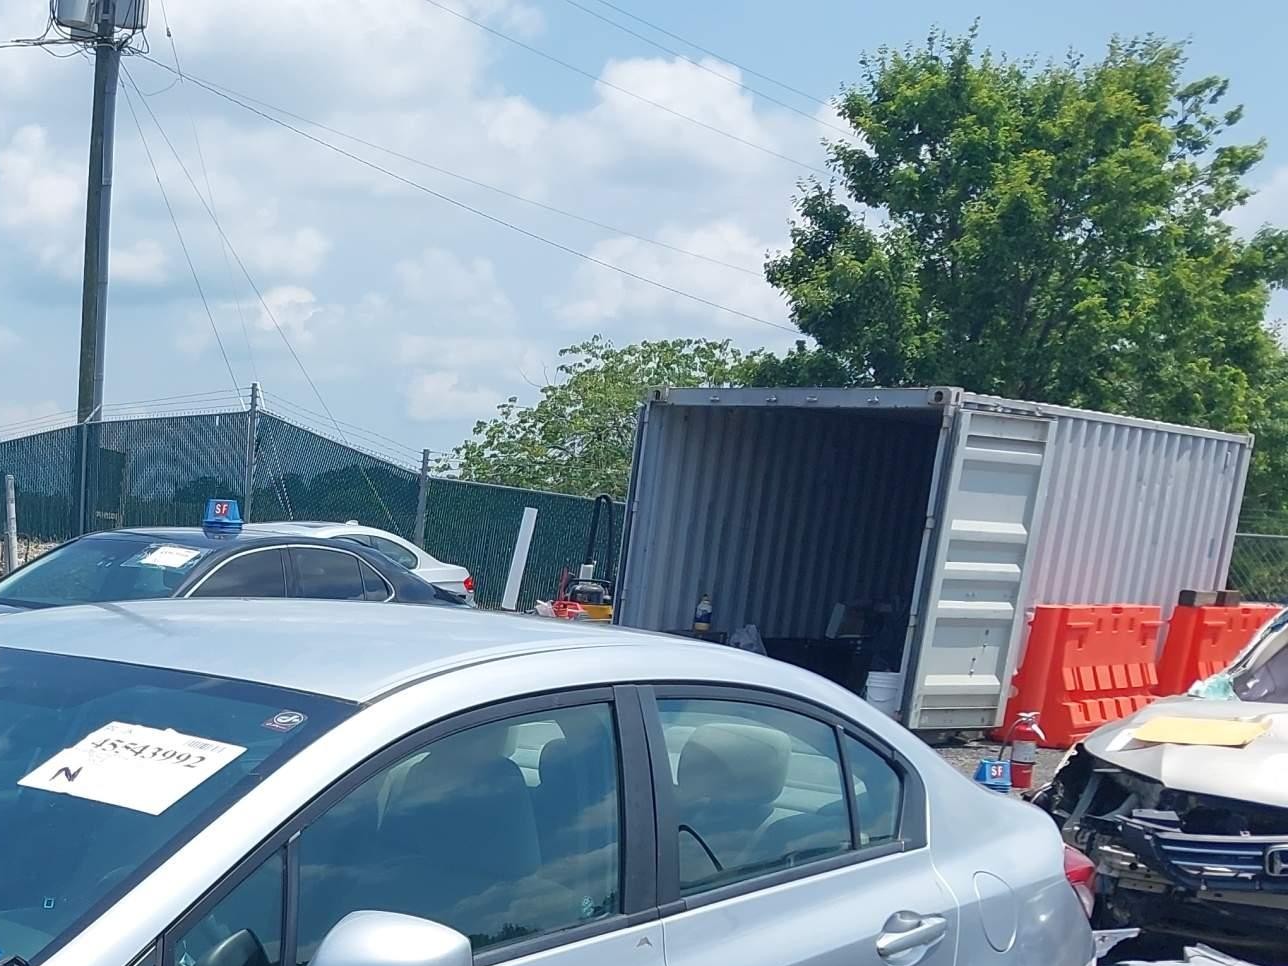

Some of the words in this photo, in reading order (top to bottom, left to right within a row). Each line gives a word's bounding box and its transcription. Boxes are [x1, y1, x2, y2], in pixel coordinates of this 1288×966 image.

[215, 503, 229, 514] SF
[91, 738, 206, 768] 45543992
[991, 765, 1003, 777] SF
